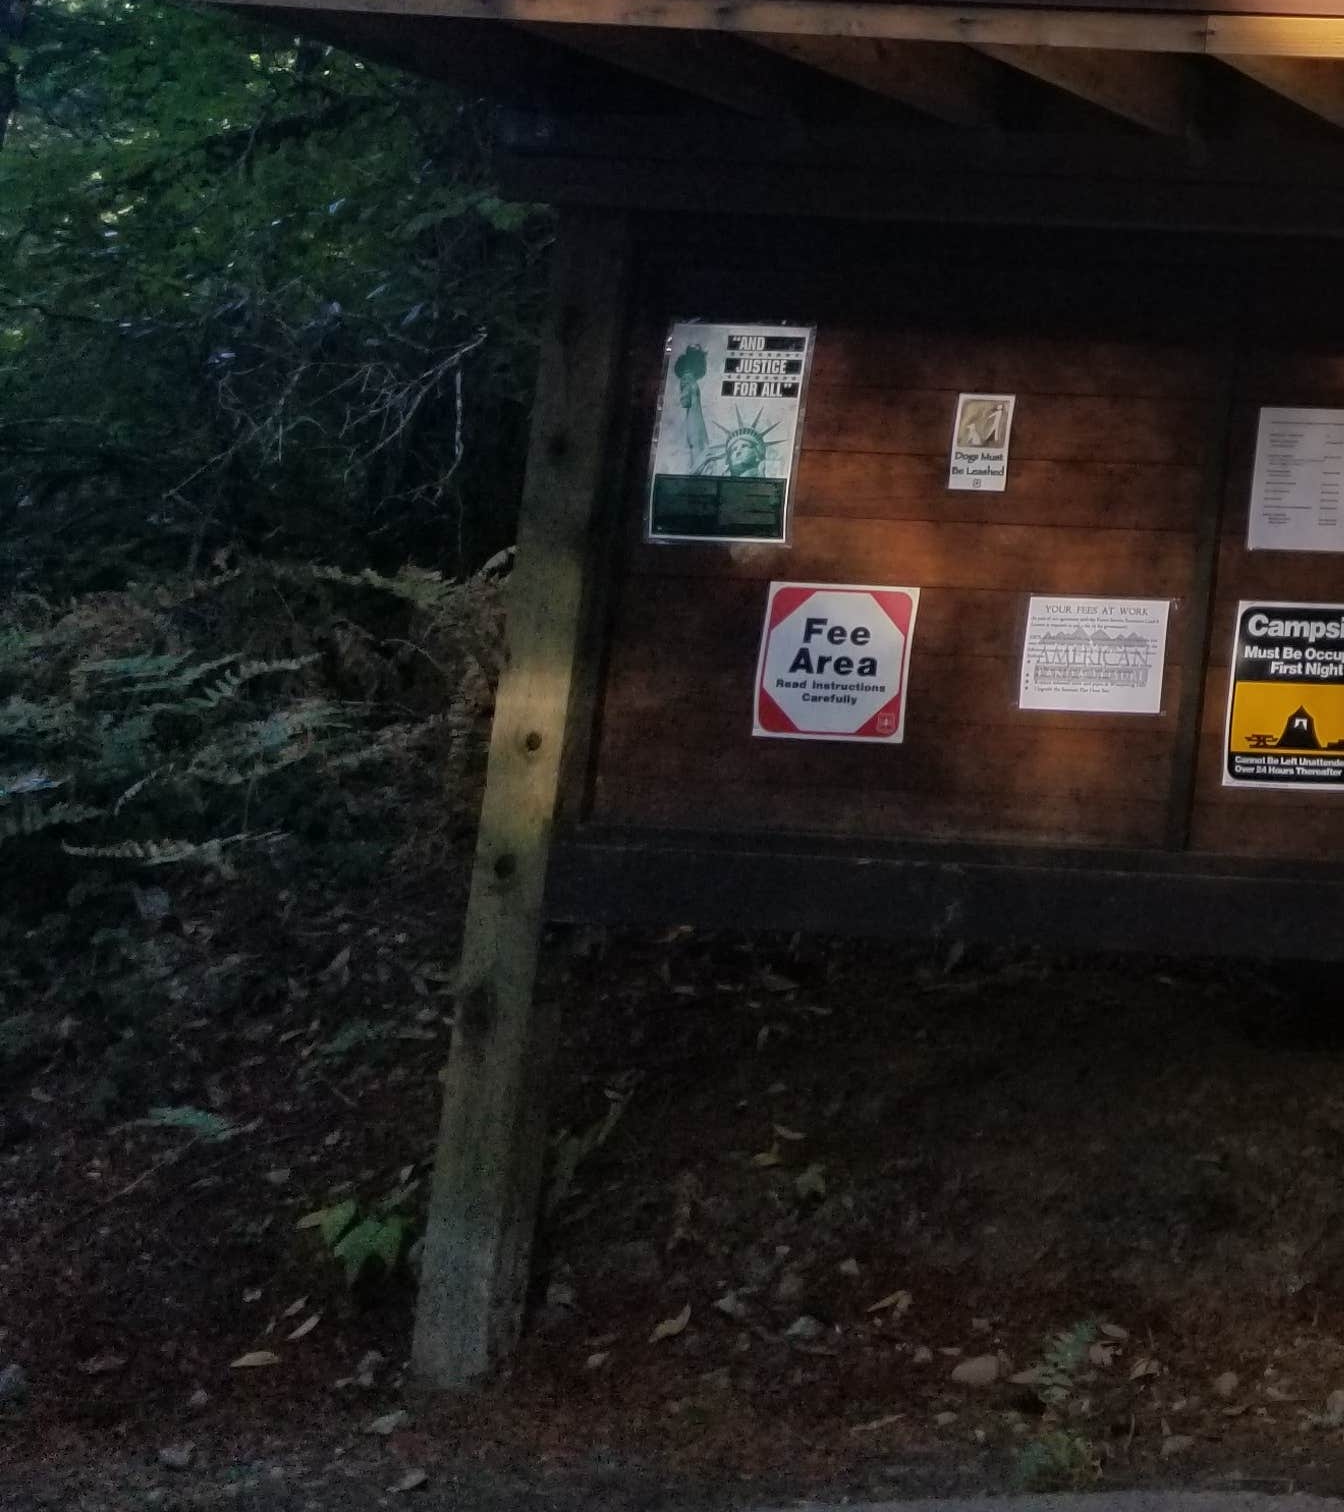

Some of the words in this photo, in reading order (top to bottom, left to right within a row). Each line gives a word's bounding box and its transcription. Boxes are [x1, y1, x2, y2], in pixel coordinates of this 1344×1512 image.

[736, 360, 786, 373] JUSTICE
[733, 383, 757, 396] FOR
[955, 452, 978, 463] Dogs
[981, 453, 1003, 461] Must
[952, 467, 964, 475] Be
[967, 466, 1004, 475] Leashed
[1046, 606, 1072, 614] YOUR
[1102, 607, 1114, 615] AT
[1120, 607, 1149, 616] WORK
[803, 618, 870, 645] Fee
[1244, 646, 1279, 659] Must
[1283, 647, 1302, 660] Be
[789, 647, 878, 676] Area
[1271, 662, 1301, 674] First
[1305, 662, 1343, 677] Night
[776, 679, 806, 688] Read
[802, 693, 857, 706] Carefully
[1235, 756, 1265, 764] Cannot
[1267, 757, 1278, 765] Be
[1269, 767, 1294, 775] Hours
[1296, 768, 1342, 776] Thereafter
